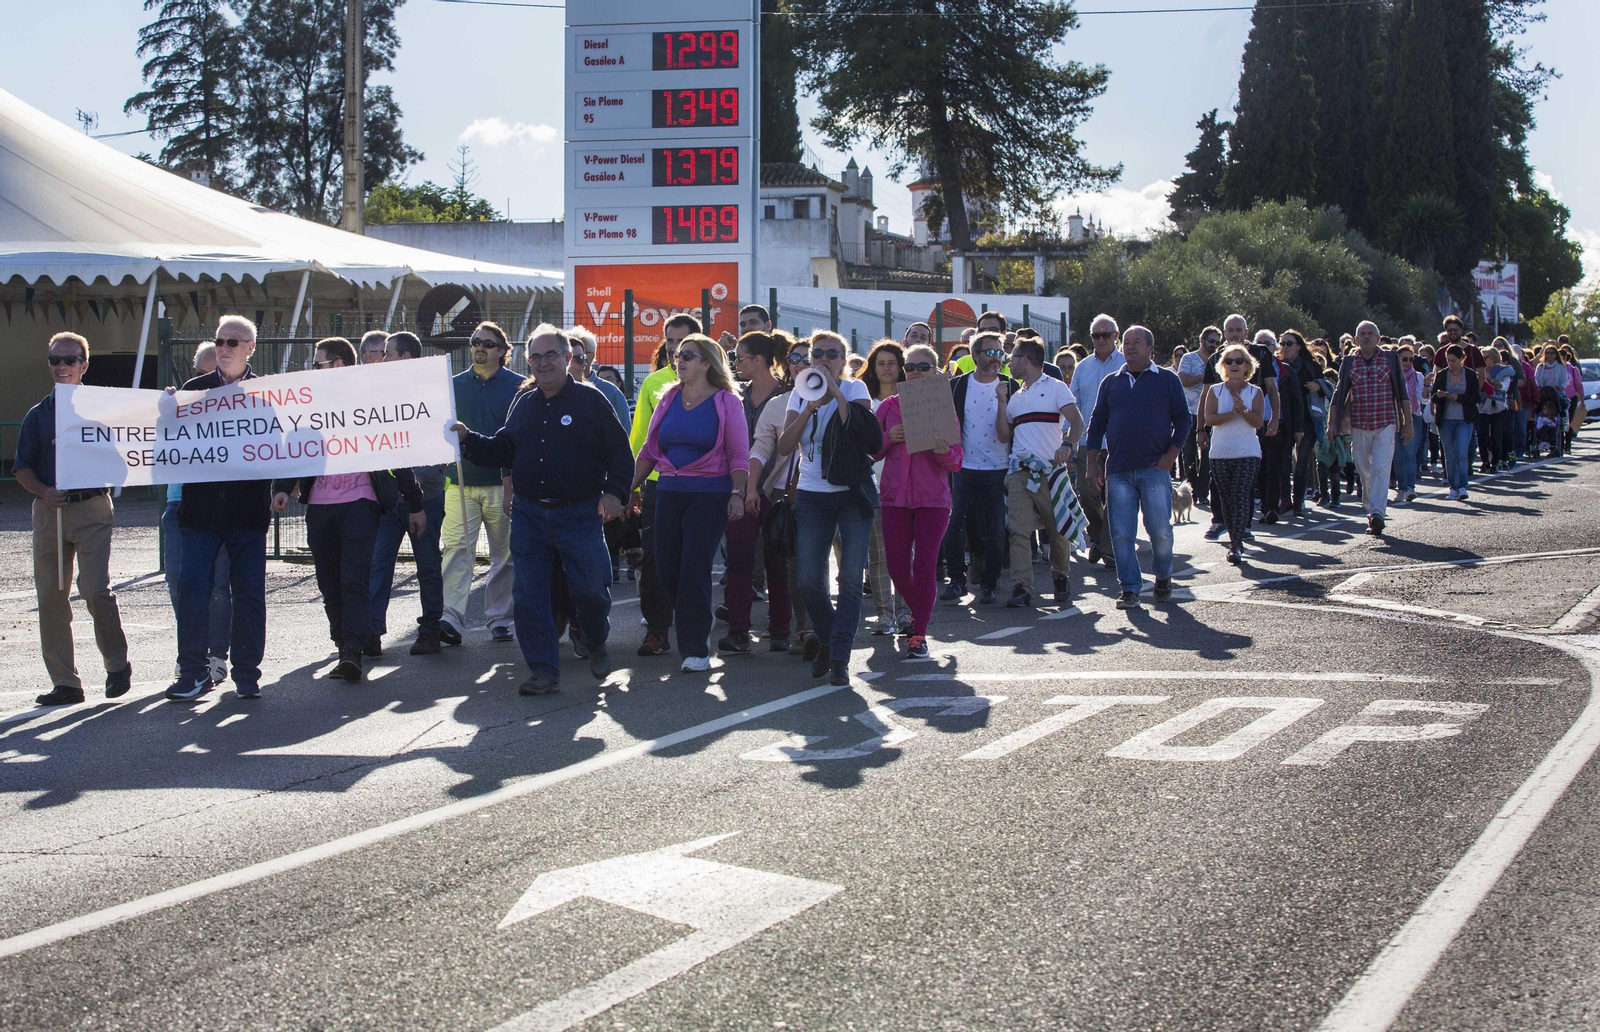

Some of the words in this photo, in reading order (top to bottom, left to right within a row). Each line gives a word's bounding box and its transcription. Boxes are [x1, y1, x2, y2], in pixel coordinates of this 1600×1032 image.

[584, 38, 609, 49] Diesel
[663, 31, 738, 68] 1.299
[584, 56, 617, 66] Gasóleo
[619, 56, 625, 65] A
[583, 97, 598, 107] Sin
[598, 97, 624, 106] Plomo
[663, 89, 738, 126] 1.349
[583, 114, 594, 124] 95
[584, 155, 618, 165] V-Power
[620, 153, 645, 164] Diesel
[663, 148, 738, 185] 1.379
[584, 172, 617, 182] Gasóleo
[618, 172, 625, 181] A
[584, 213, 618, 223] V-Power
[663, 206, 738, 243] 1.489
[583, 230, 598, 240] Sin
[598, 229, 624, 239] Plomo
[626, 229, 637, 238] 98
[586, 286, 612, 297] Shell
[595, 332, 660, 344] erforance
[176, 387, 313, 419] ESPARTINAS
[81, 426, 156, 443] ENTRE
[164, 424, 192, 442] LA
[197, 414, 284, 439] MIERDA
[288, 414, 303, 430] Y
[310, 409, 346, 429] SIN
[353, 401, 430, 426] SALIDA
[126, 446, 229, 467] SE40-A49
[242, 434, 358, 463] SOLUCIÓN
[365, 430, 410, 452] YA!!!
[741, 696, 1490, 767] STOP
